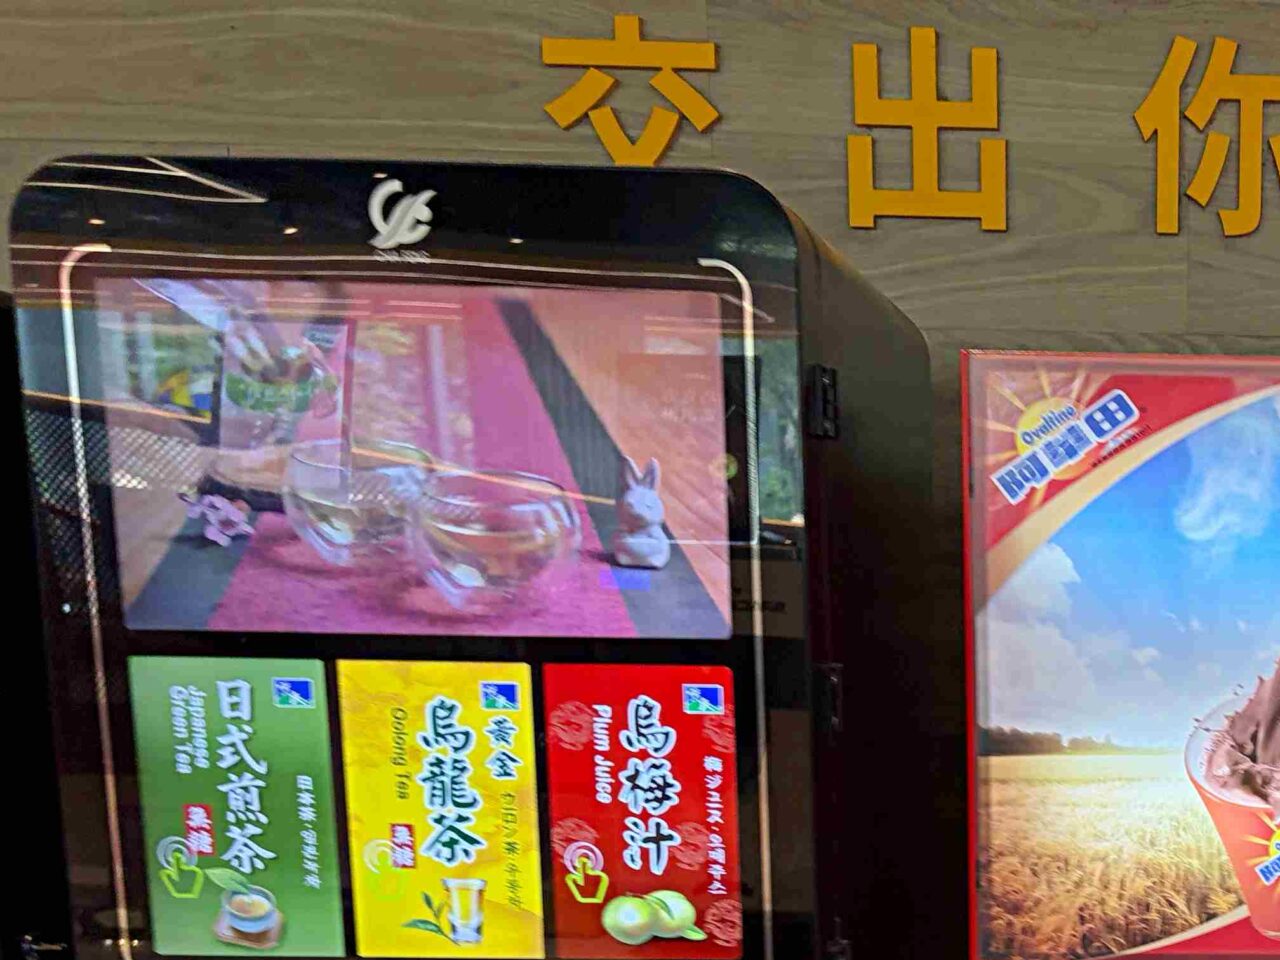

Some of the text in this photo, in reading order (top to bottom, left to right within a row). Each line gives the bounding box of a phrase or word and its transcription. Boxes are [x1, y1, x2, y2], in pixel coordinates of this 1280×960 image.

[1021, 404, 1076, 445] Ovaltine
[216, 679, 277, 874] 日式煎茶
[391, 707, 409, 766] Oolong
[417, 697, 487, 866] 烏龍茶
[592, 704, 615, 804] Plum Juice
[618, 694, 682, 876] 烏梅汁
